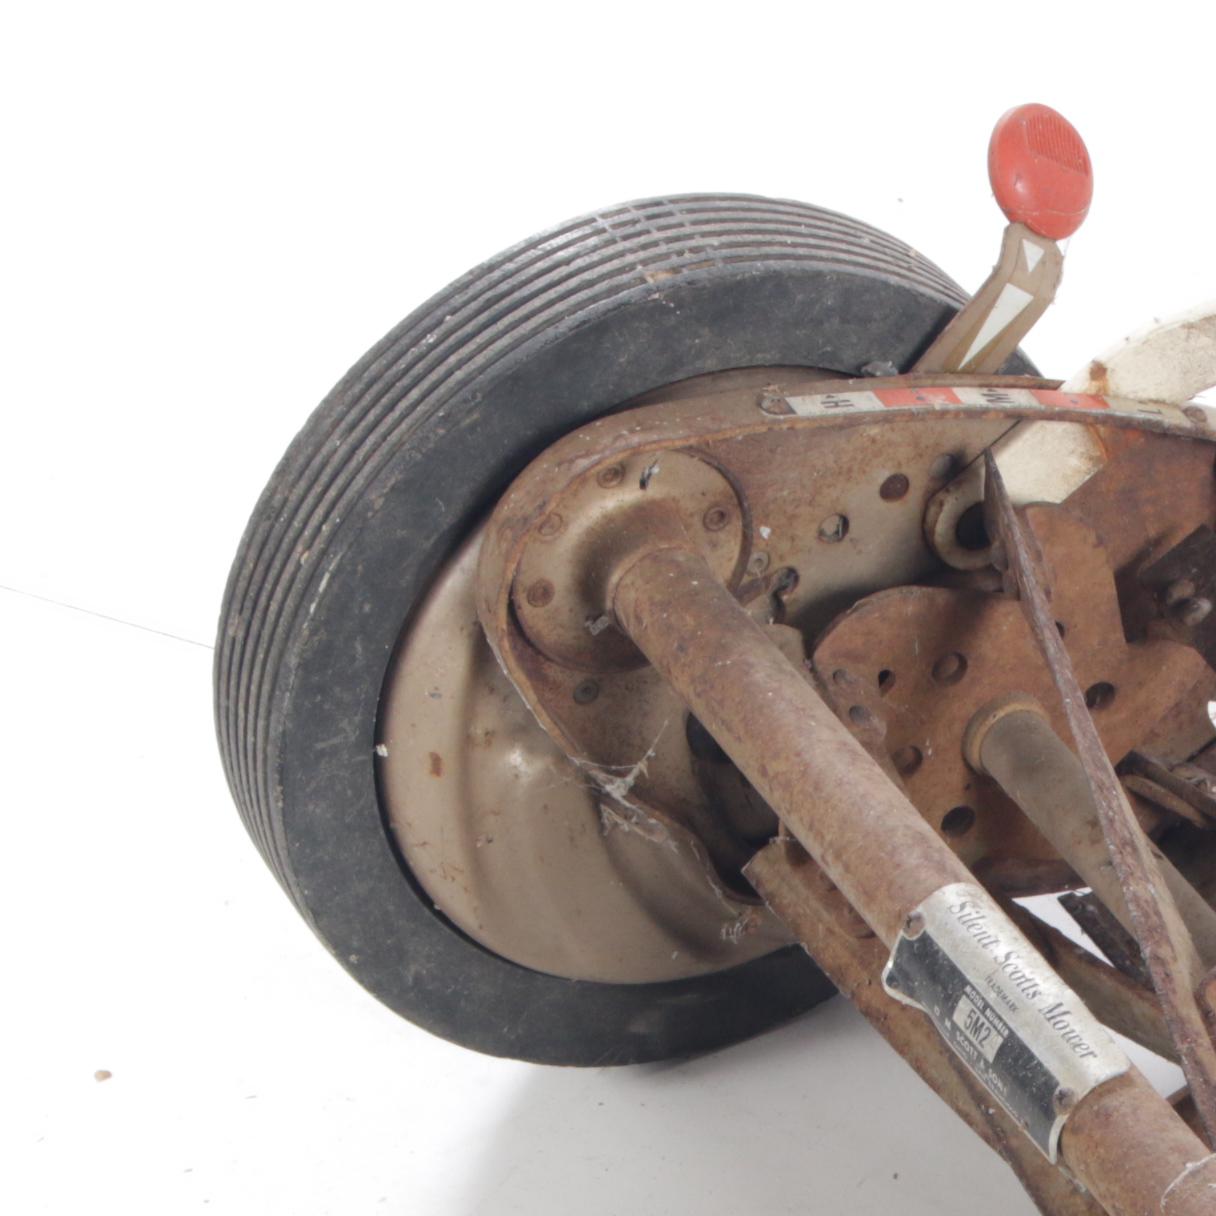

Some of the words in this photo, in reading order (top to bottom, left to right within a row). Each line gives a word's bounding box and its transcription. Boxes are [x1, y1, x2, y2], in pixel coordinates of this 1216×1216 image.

[949, 900, 1000, 949] Silent
[994, 950, 1043, 1000] Scotts
[1038, 1001, 1098, 1059] Mower
[963, 985, 985, 1011] MODEL
[984, 1008, 1010, 1037] NUMBER
[963, 1008, 991, 1048] 5M2
